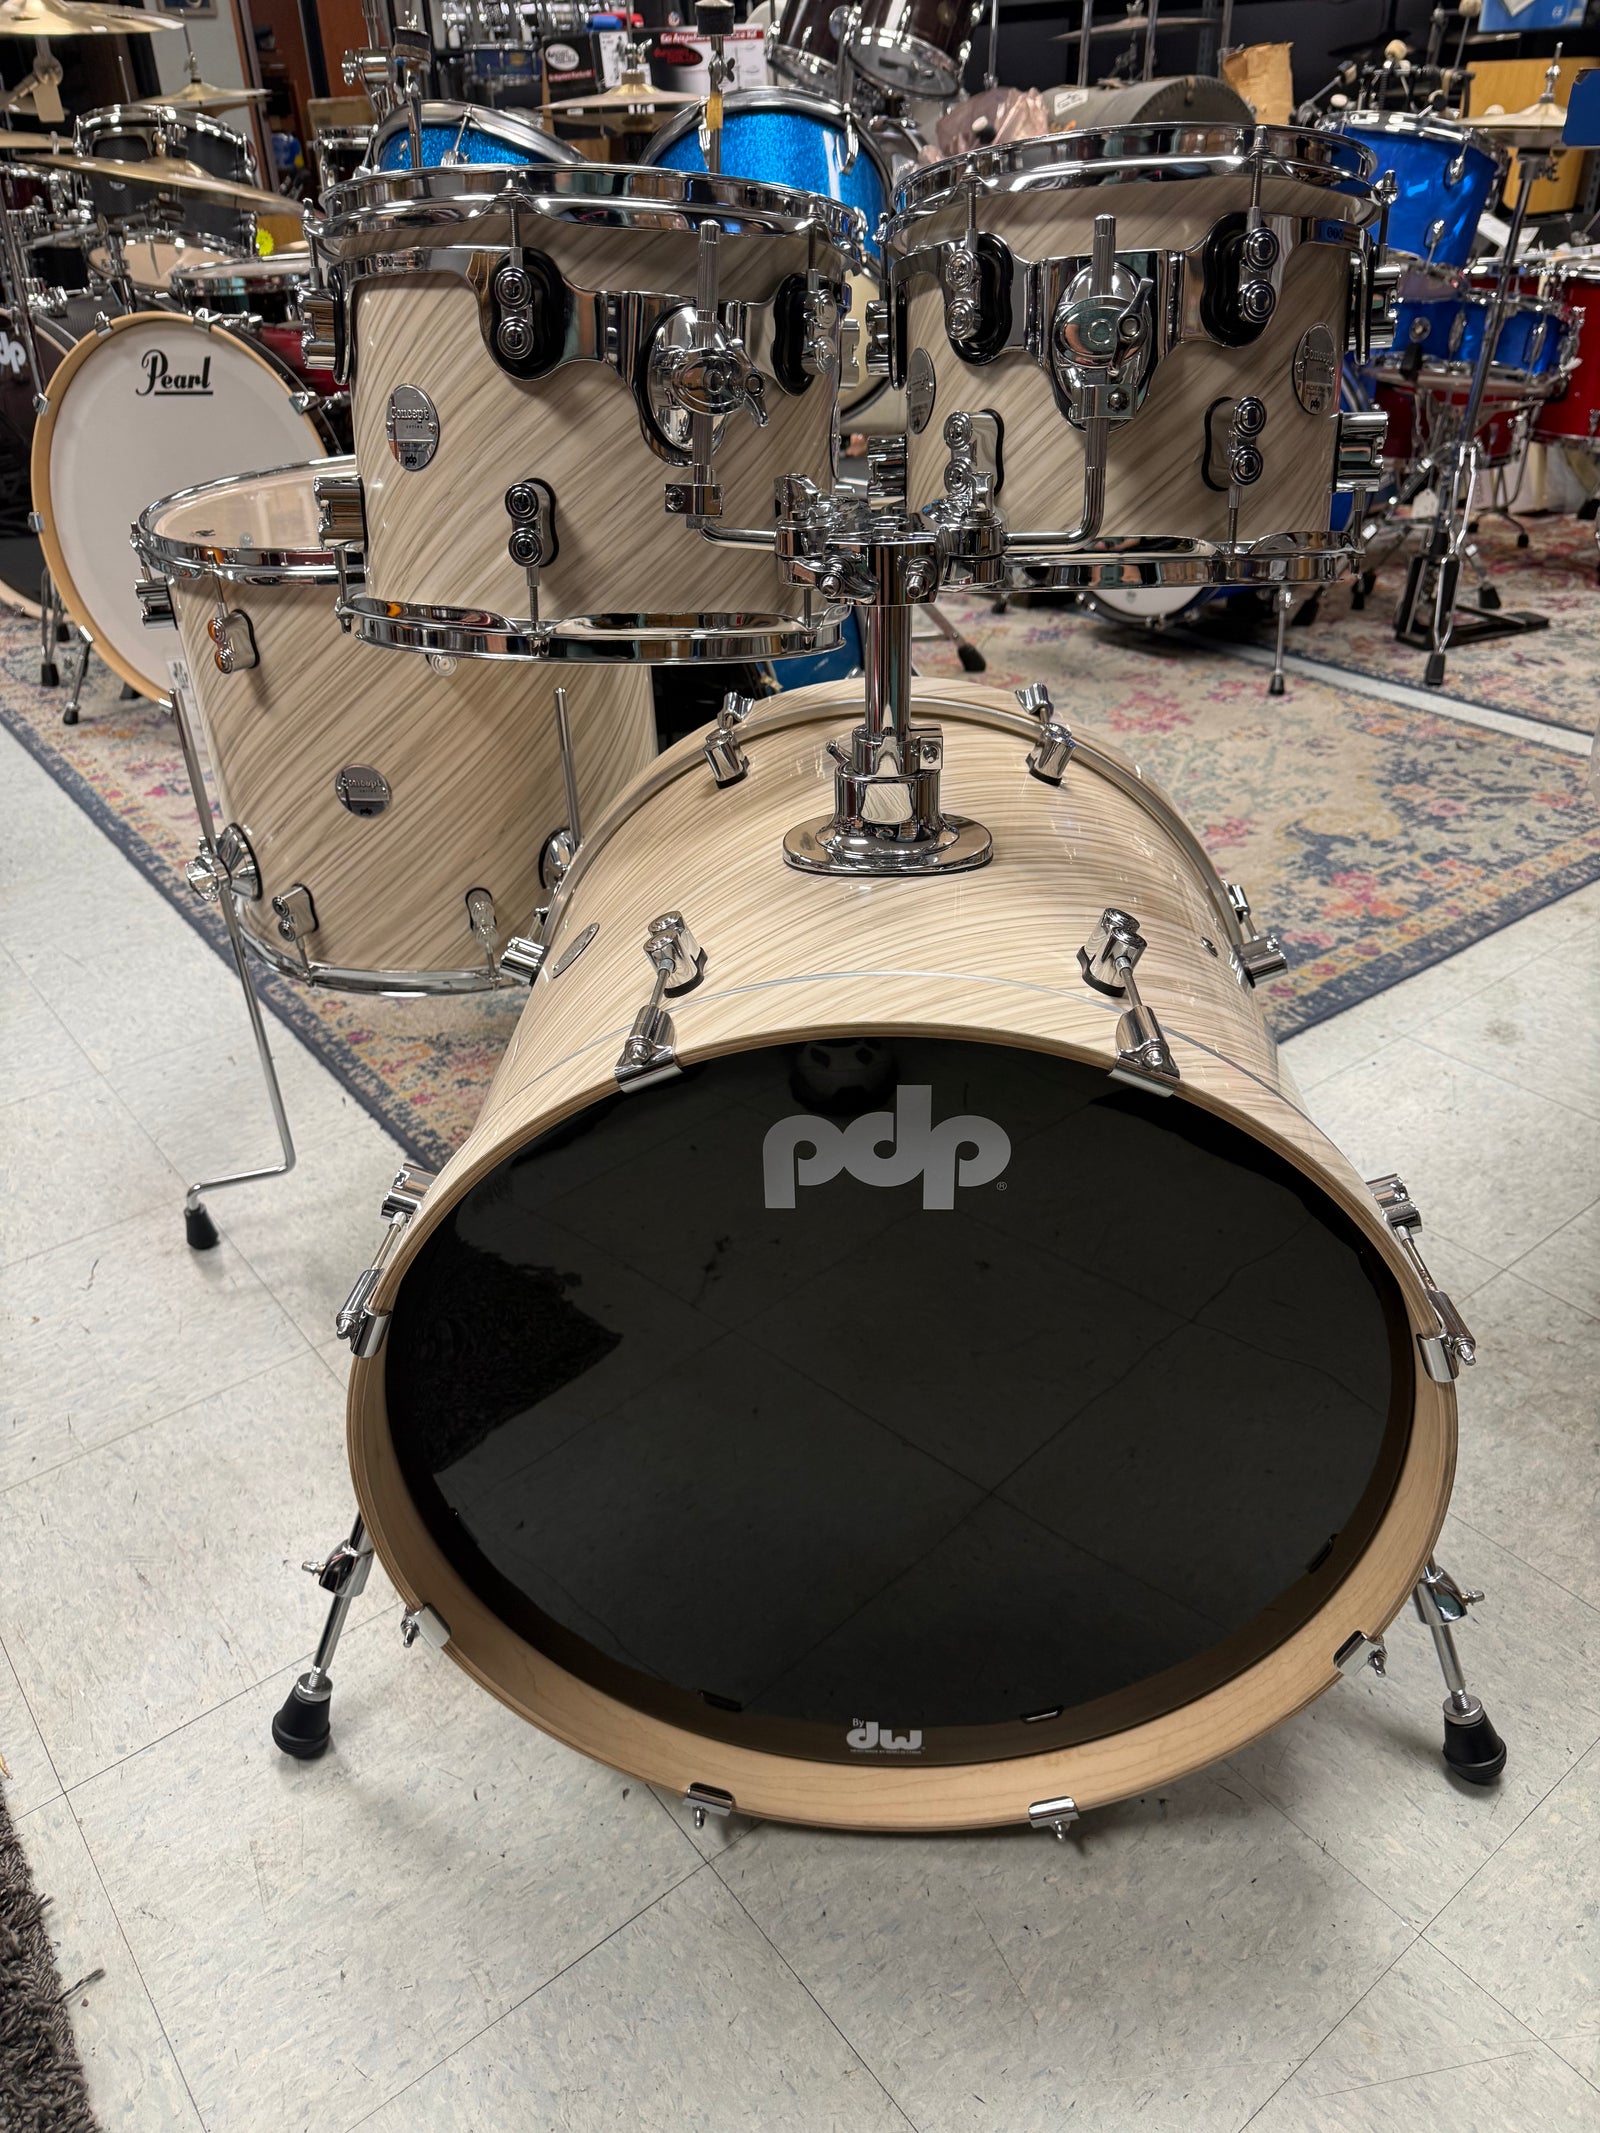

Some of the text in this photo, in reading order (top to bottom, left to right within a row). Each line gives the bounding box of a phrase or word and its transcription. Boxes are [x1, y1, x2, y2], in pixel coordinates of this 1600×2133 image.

[136, 349, 211, 396] Pearl
[1310, 397, 1321, 411] pdp
[391, 406, 430, 423] Concept
[405, 453, 418, 466] pdp
[341, 777, 383, 789] Concept
[763, 1084, 1012, 1210] pdp
[852, 1718, 865, 1728] By
[846, 1721, 923, 1751] dw
